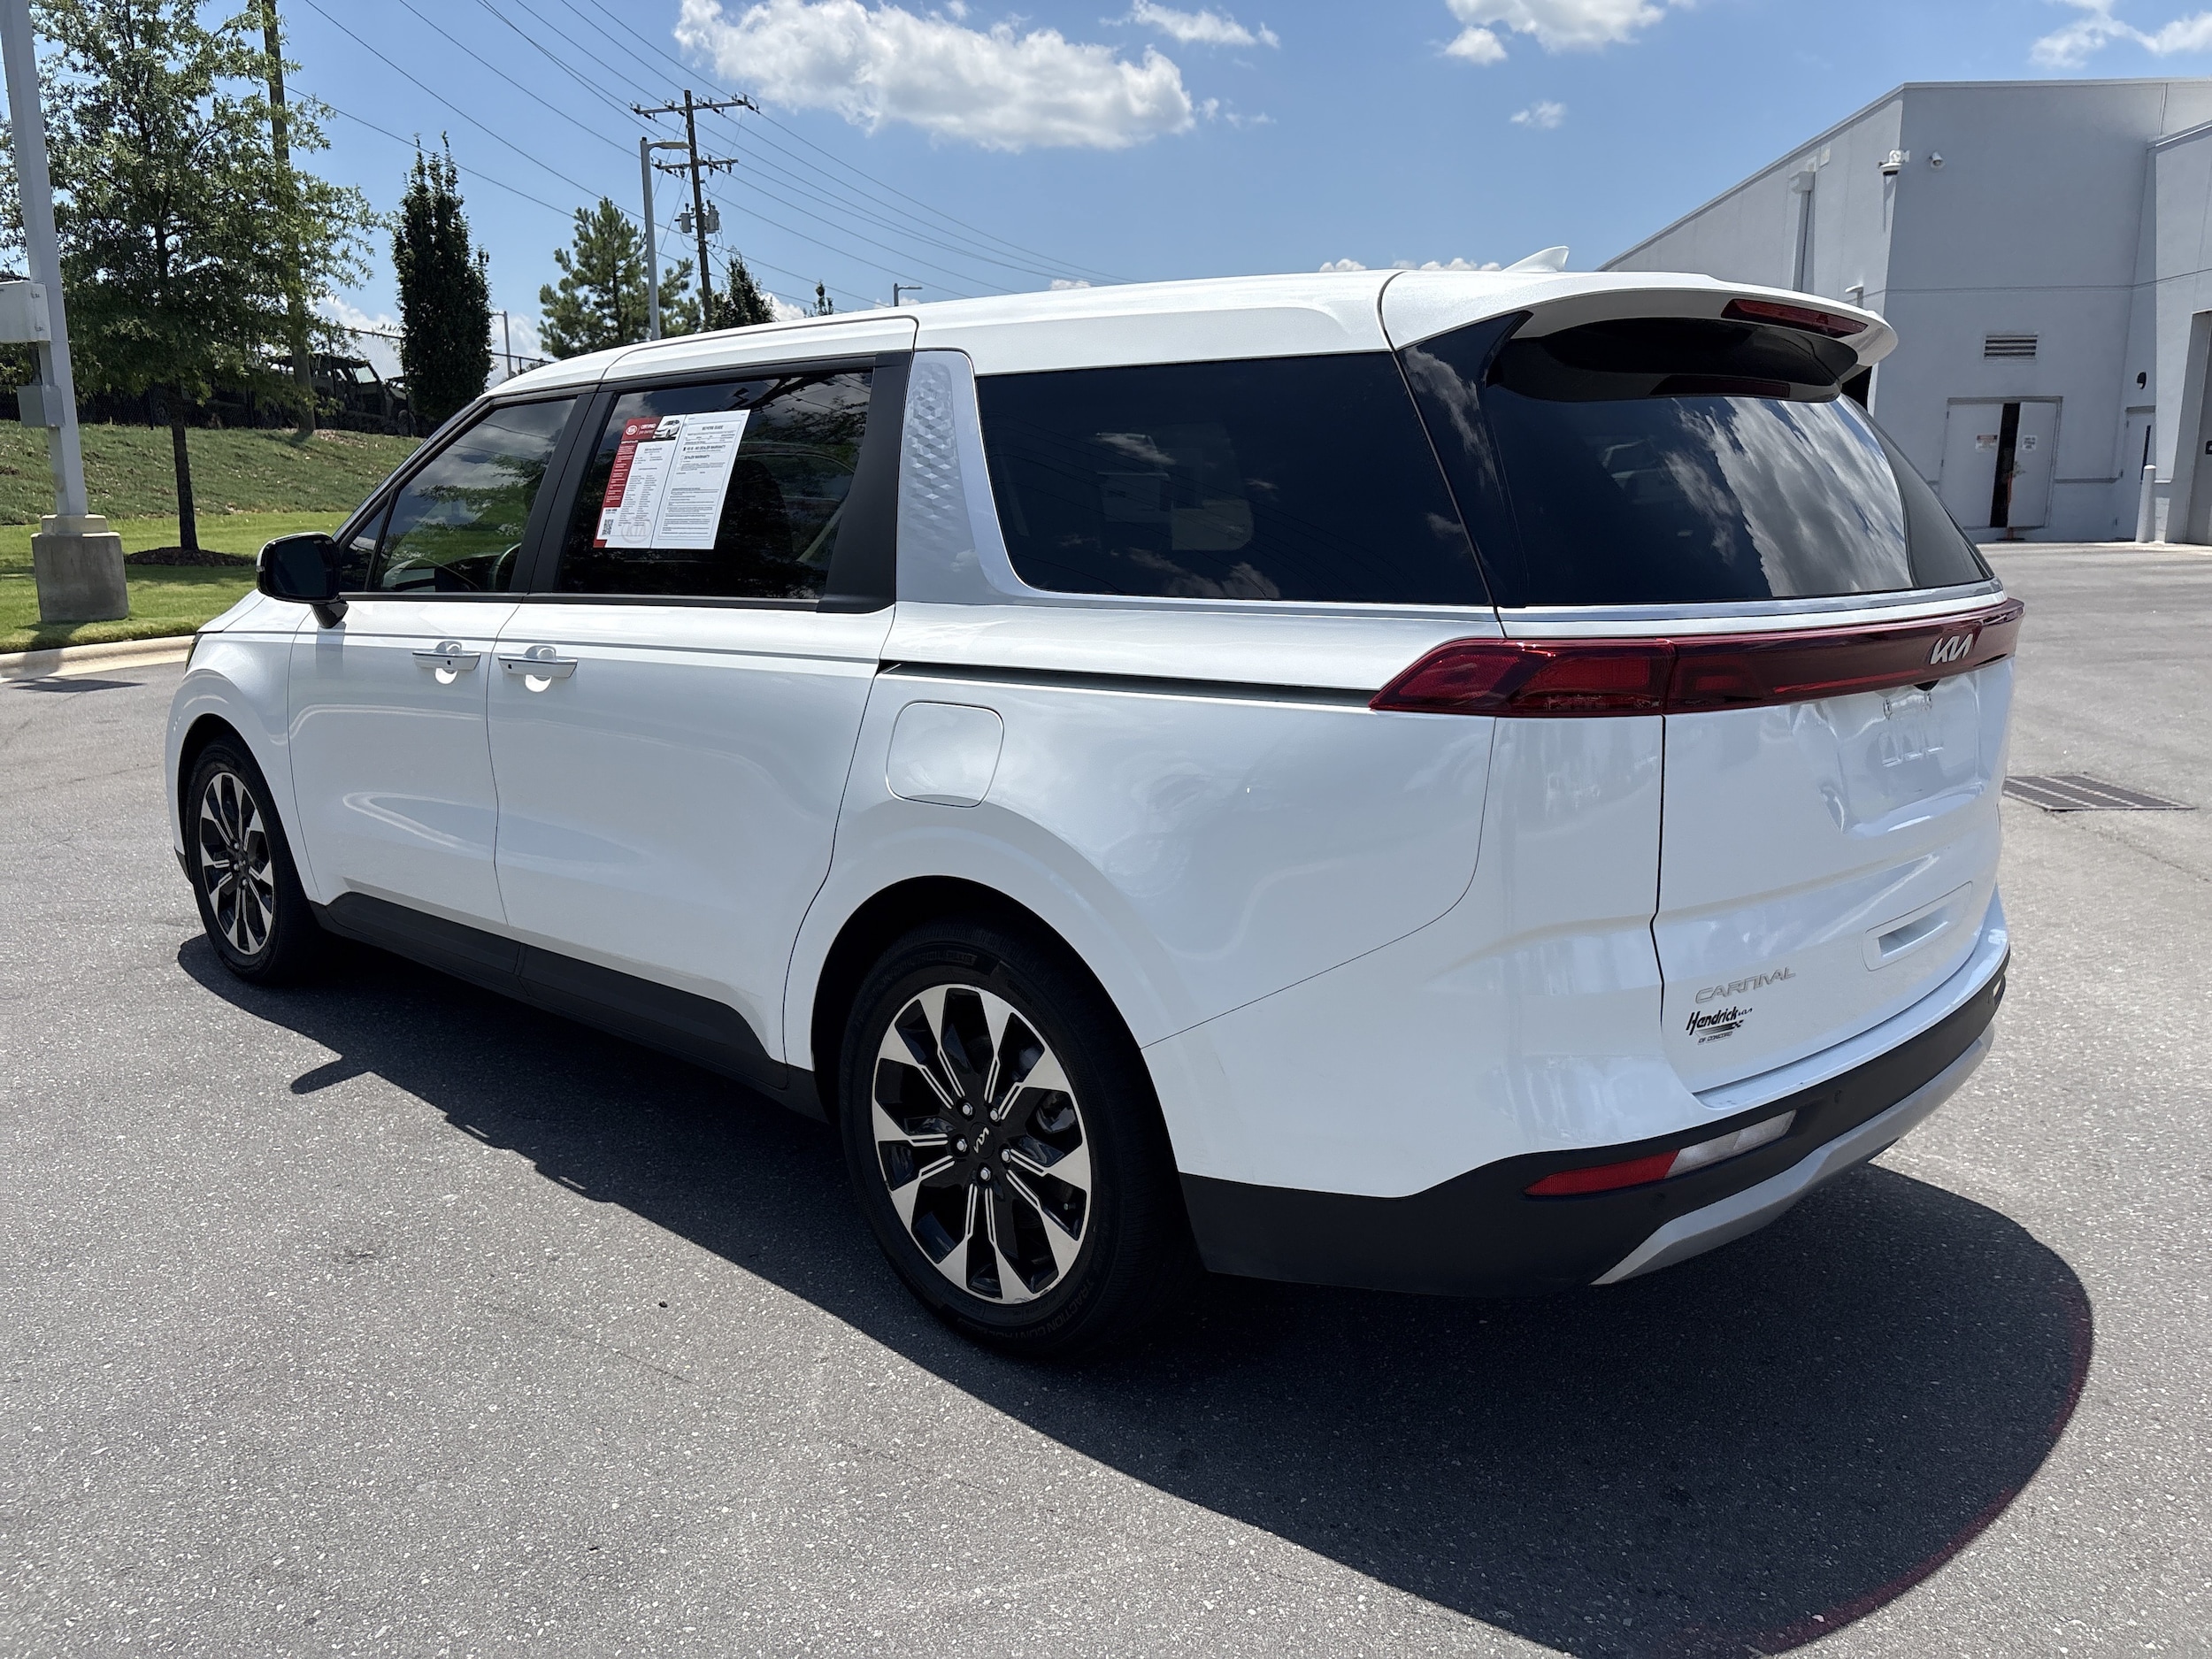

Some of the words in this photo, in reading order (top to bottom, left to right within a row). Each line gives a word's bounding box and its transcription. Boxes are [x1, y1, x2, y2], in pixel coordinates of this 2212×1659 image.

[1930, 633, 1974, 664] KIA
[1695, 966, 1796, 1003] CARNIVAL
[1686, 1006, 1739, 1036] Hendrick
